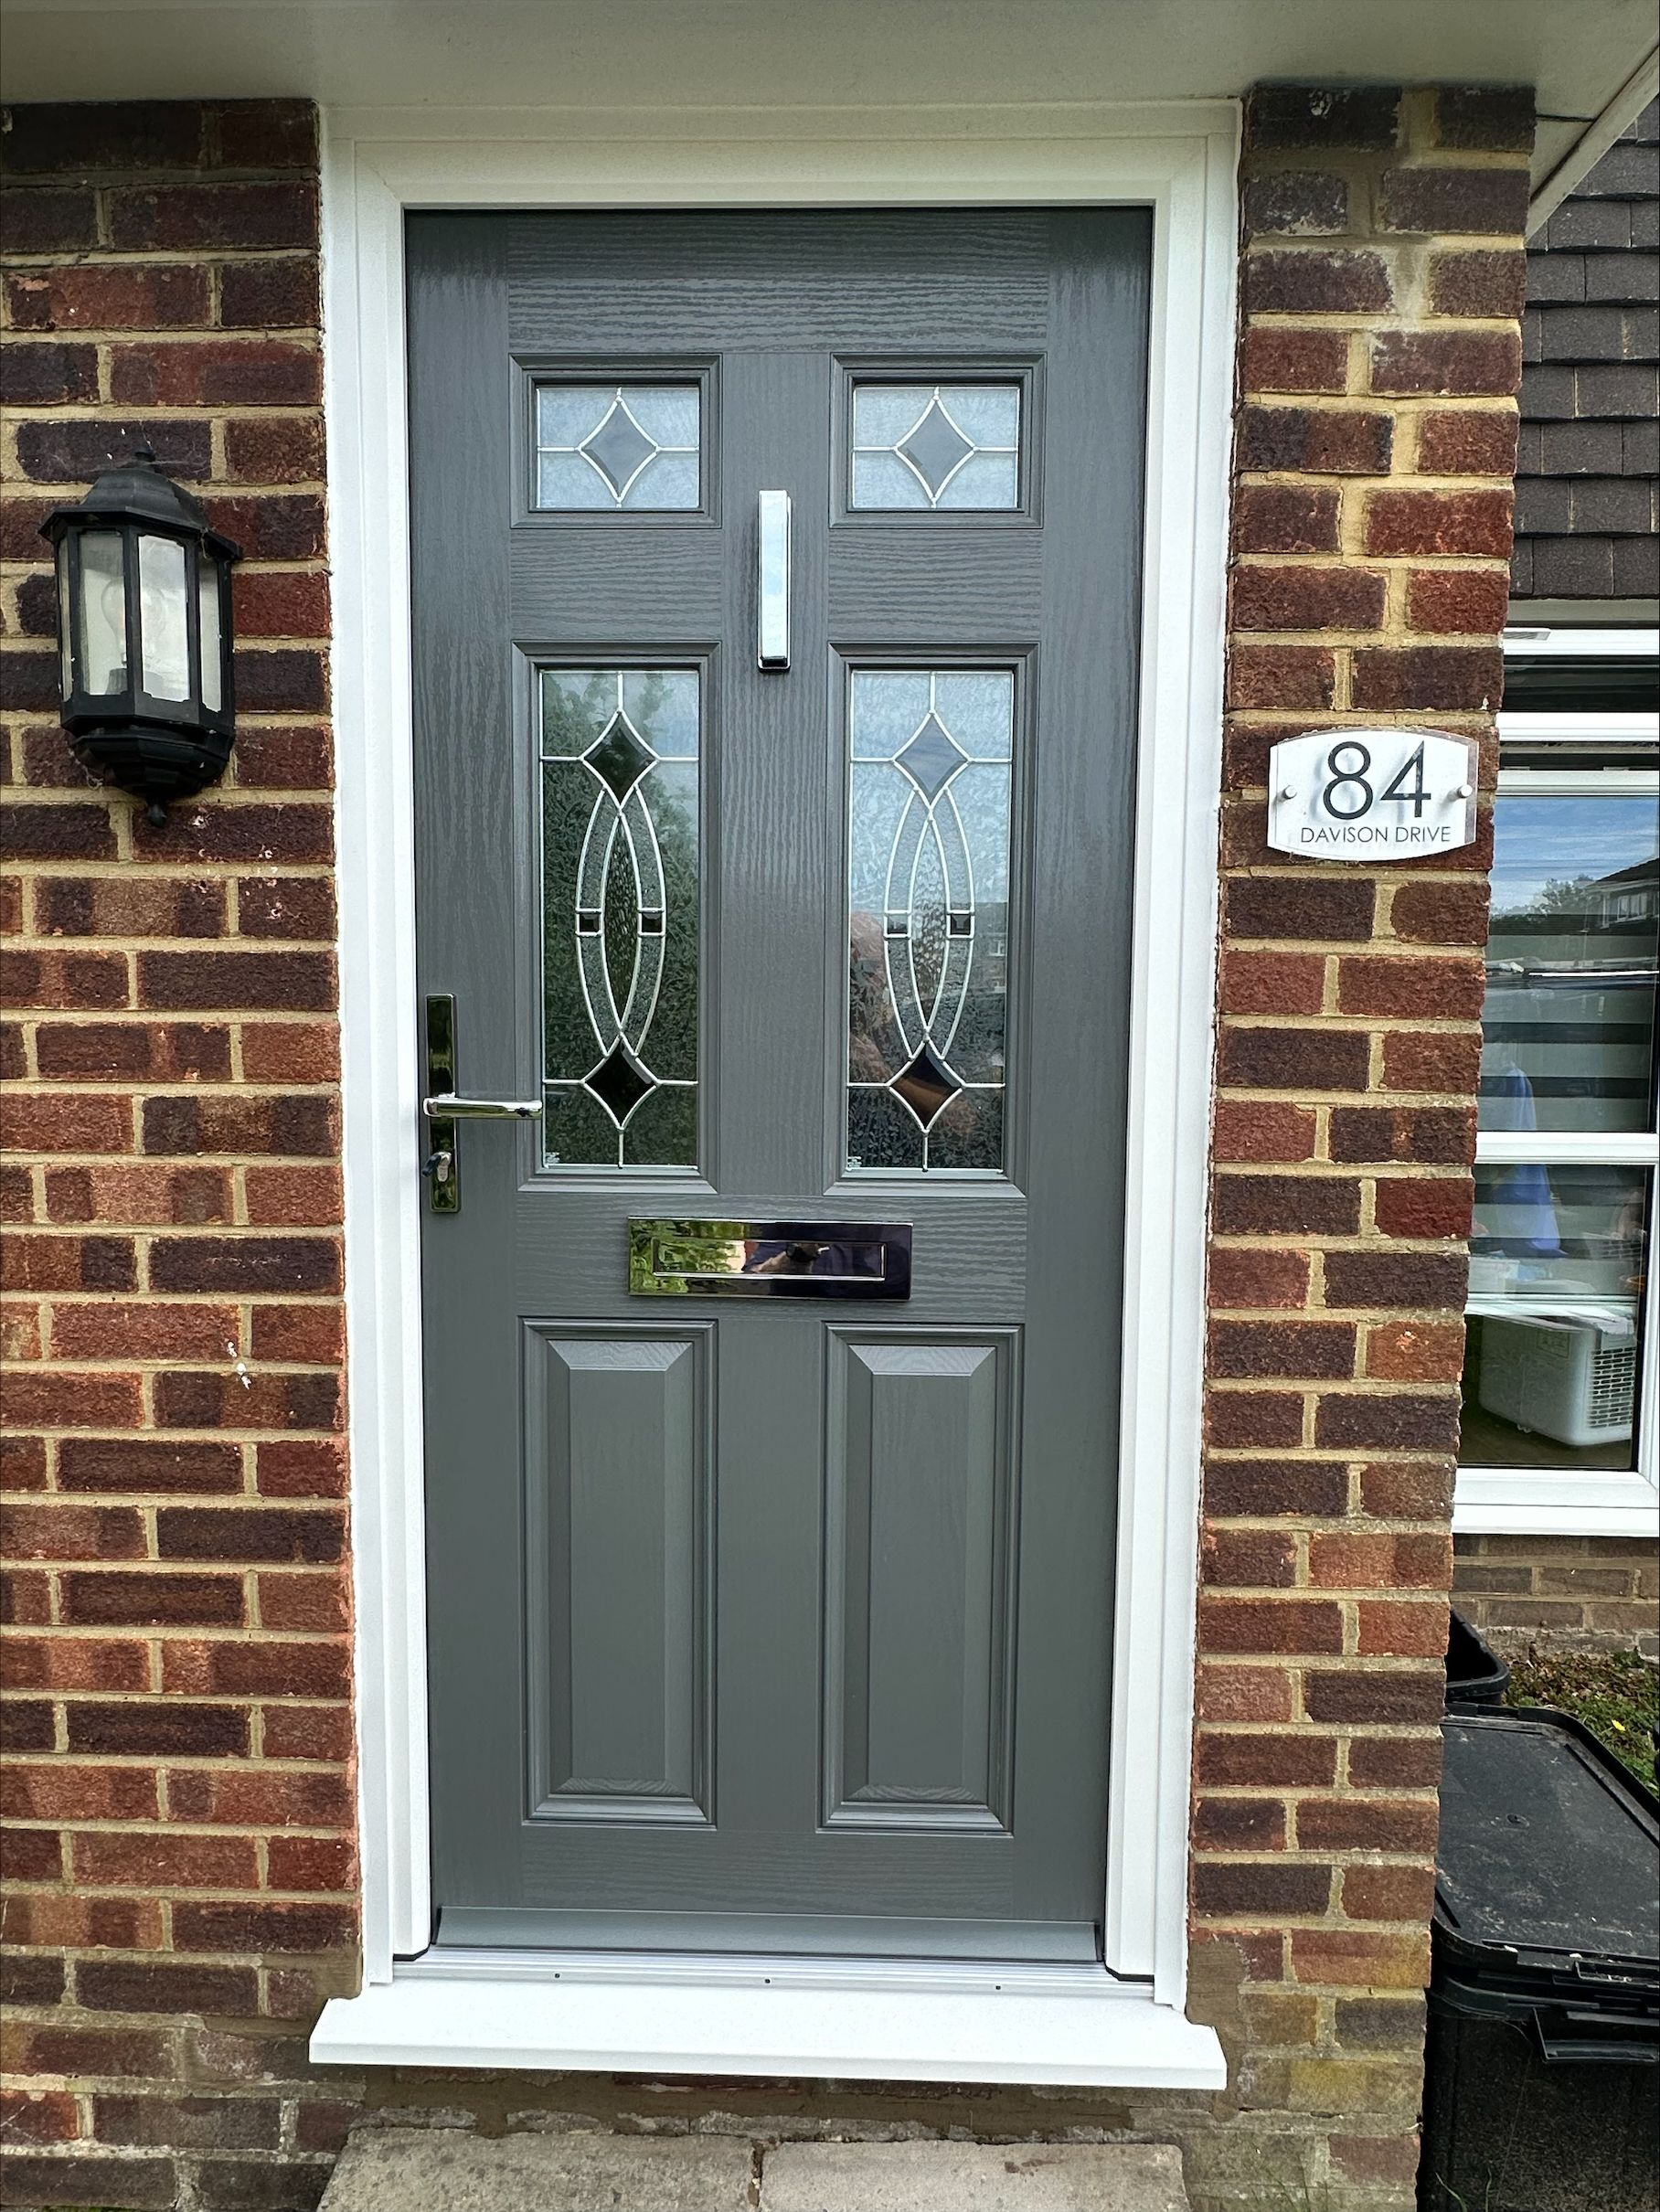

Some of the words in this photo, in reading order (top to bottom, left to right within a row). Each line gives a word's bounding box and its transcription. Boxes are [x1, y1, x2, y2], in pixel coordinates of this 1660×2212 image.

[1323, 740, 1431, 820] 84
[1301, 826, 1389, 843] DAVISON
[1395, 826, 1451, 842] DRIVE
